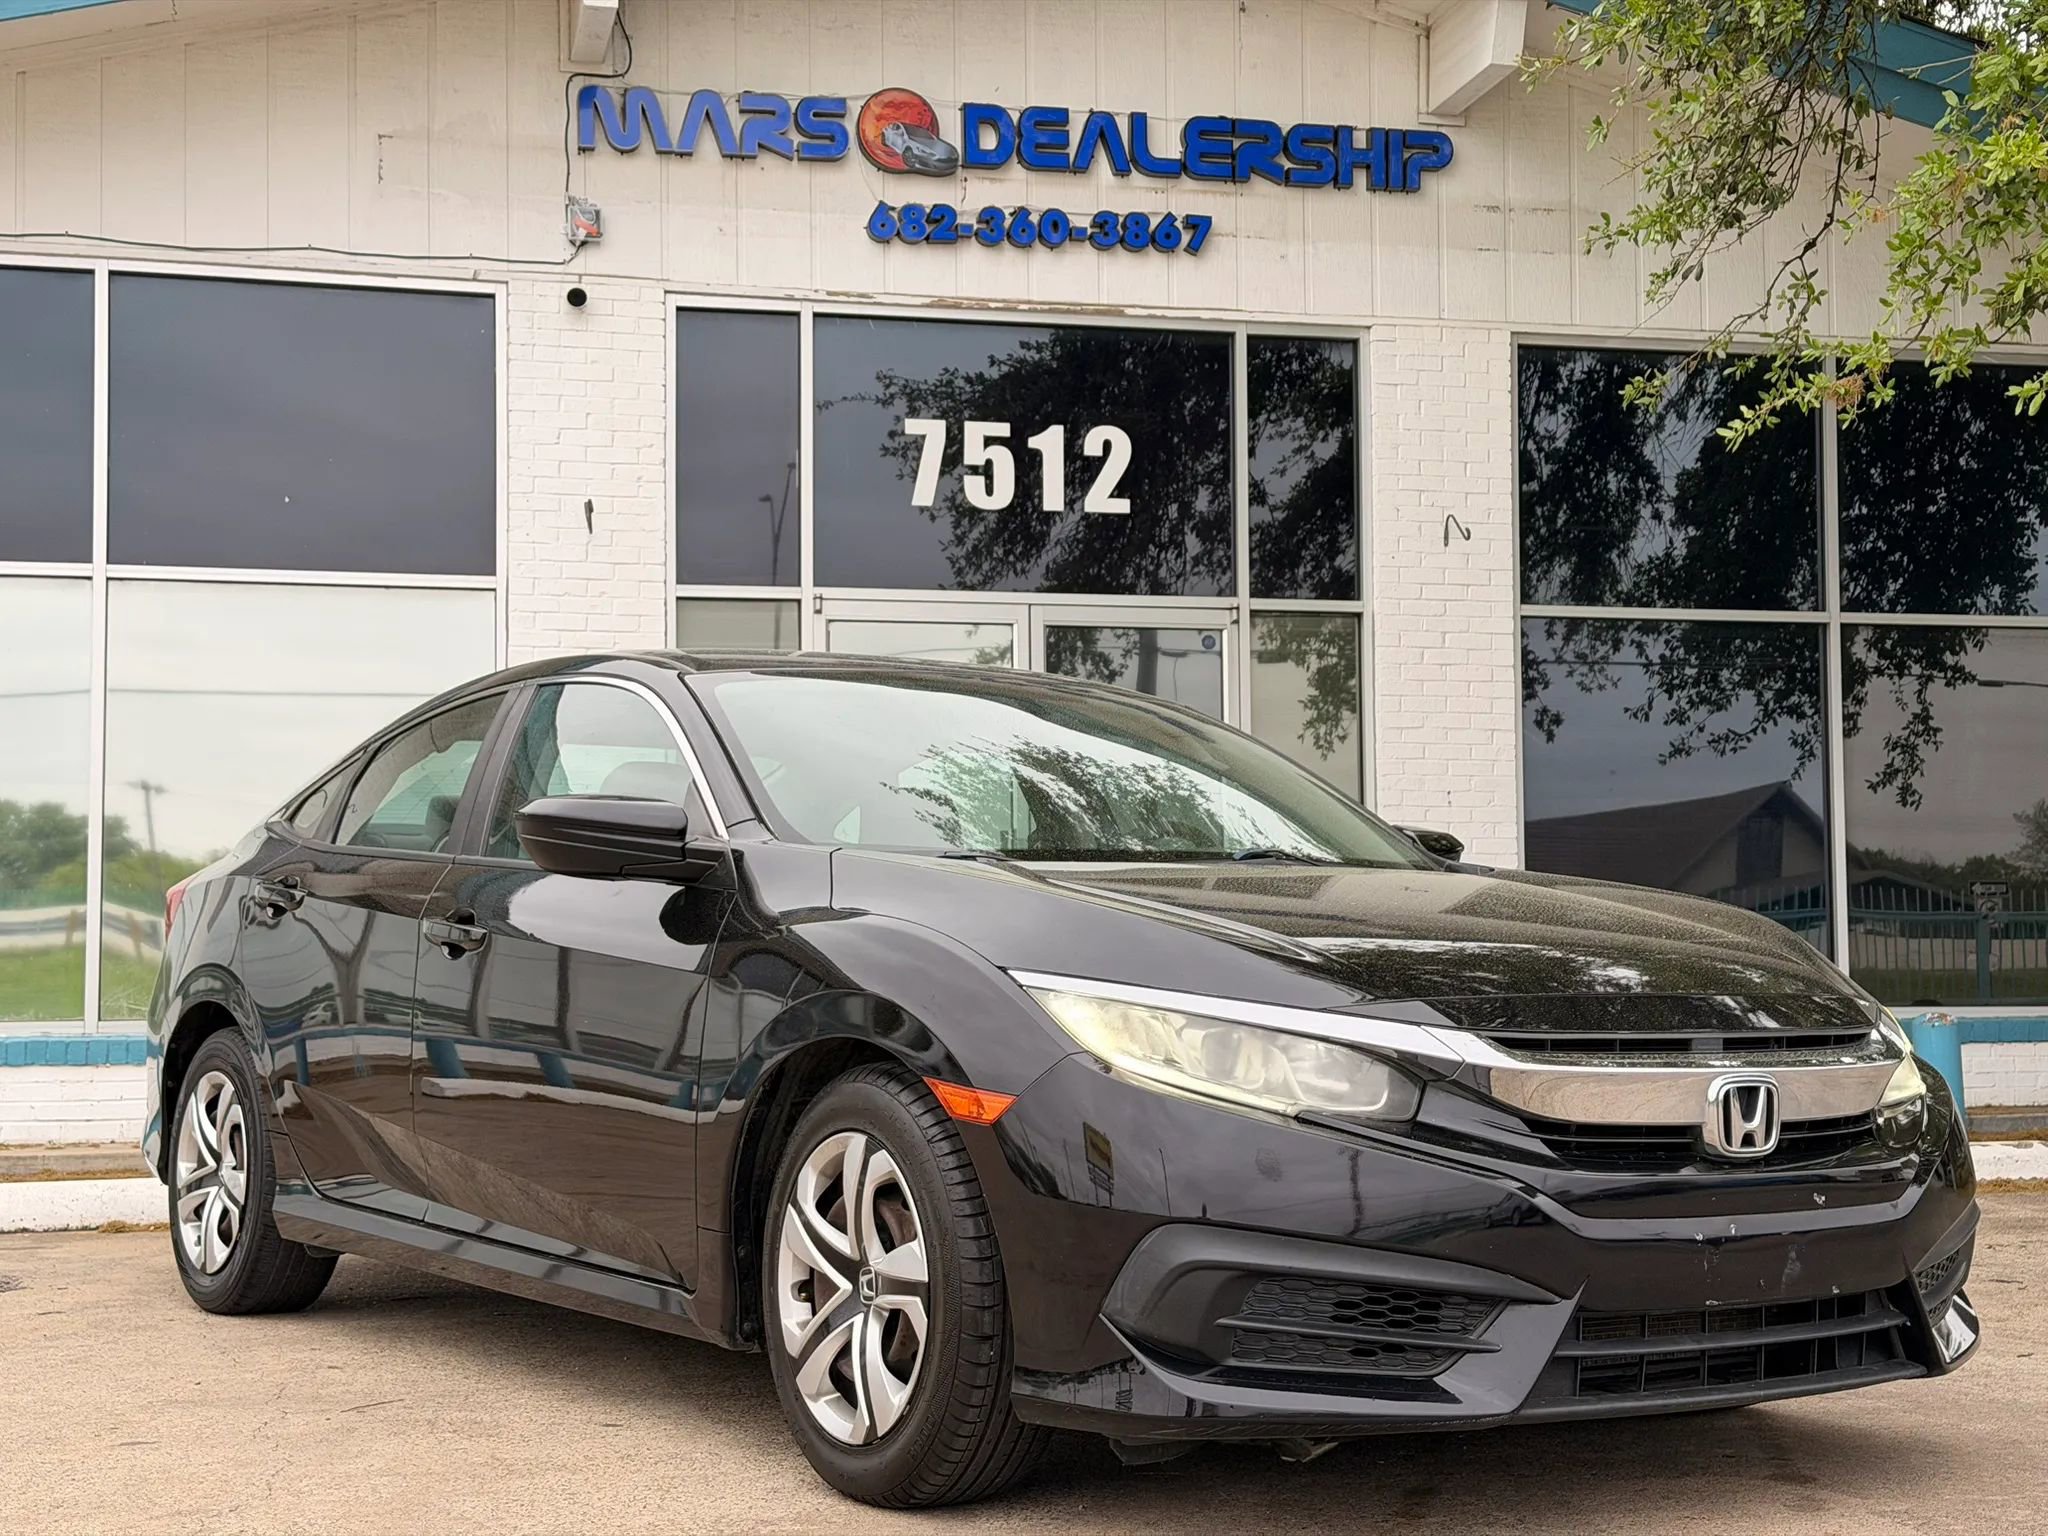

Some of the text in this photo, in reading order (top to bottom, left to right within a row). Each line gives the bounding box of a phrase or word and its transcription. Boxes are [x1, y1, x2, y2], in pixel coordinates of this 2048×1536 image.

[577, 85, 1454, 192] MARS DEALERSHIP
[866, 200, 1213, 256] 682-360-3867
[904, 418, 1133, 514] 7512
